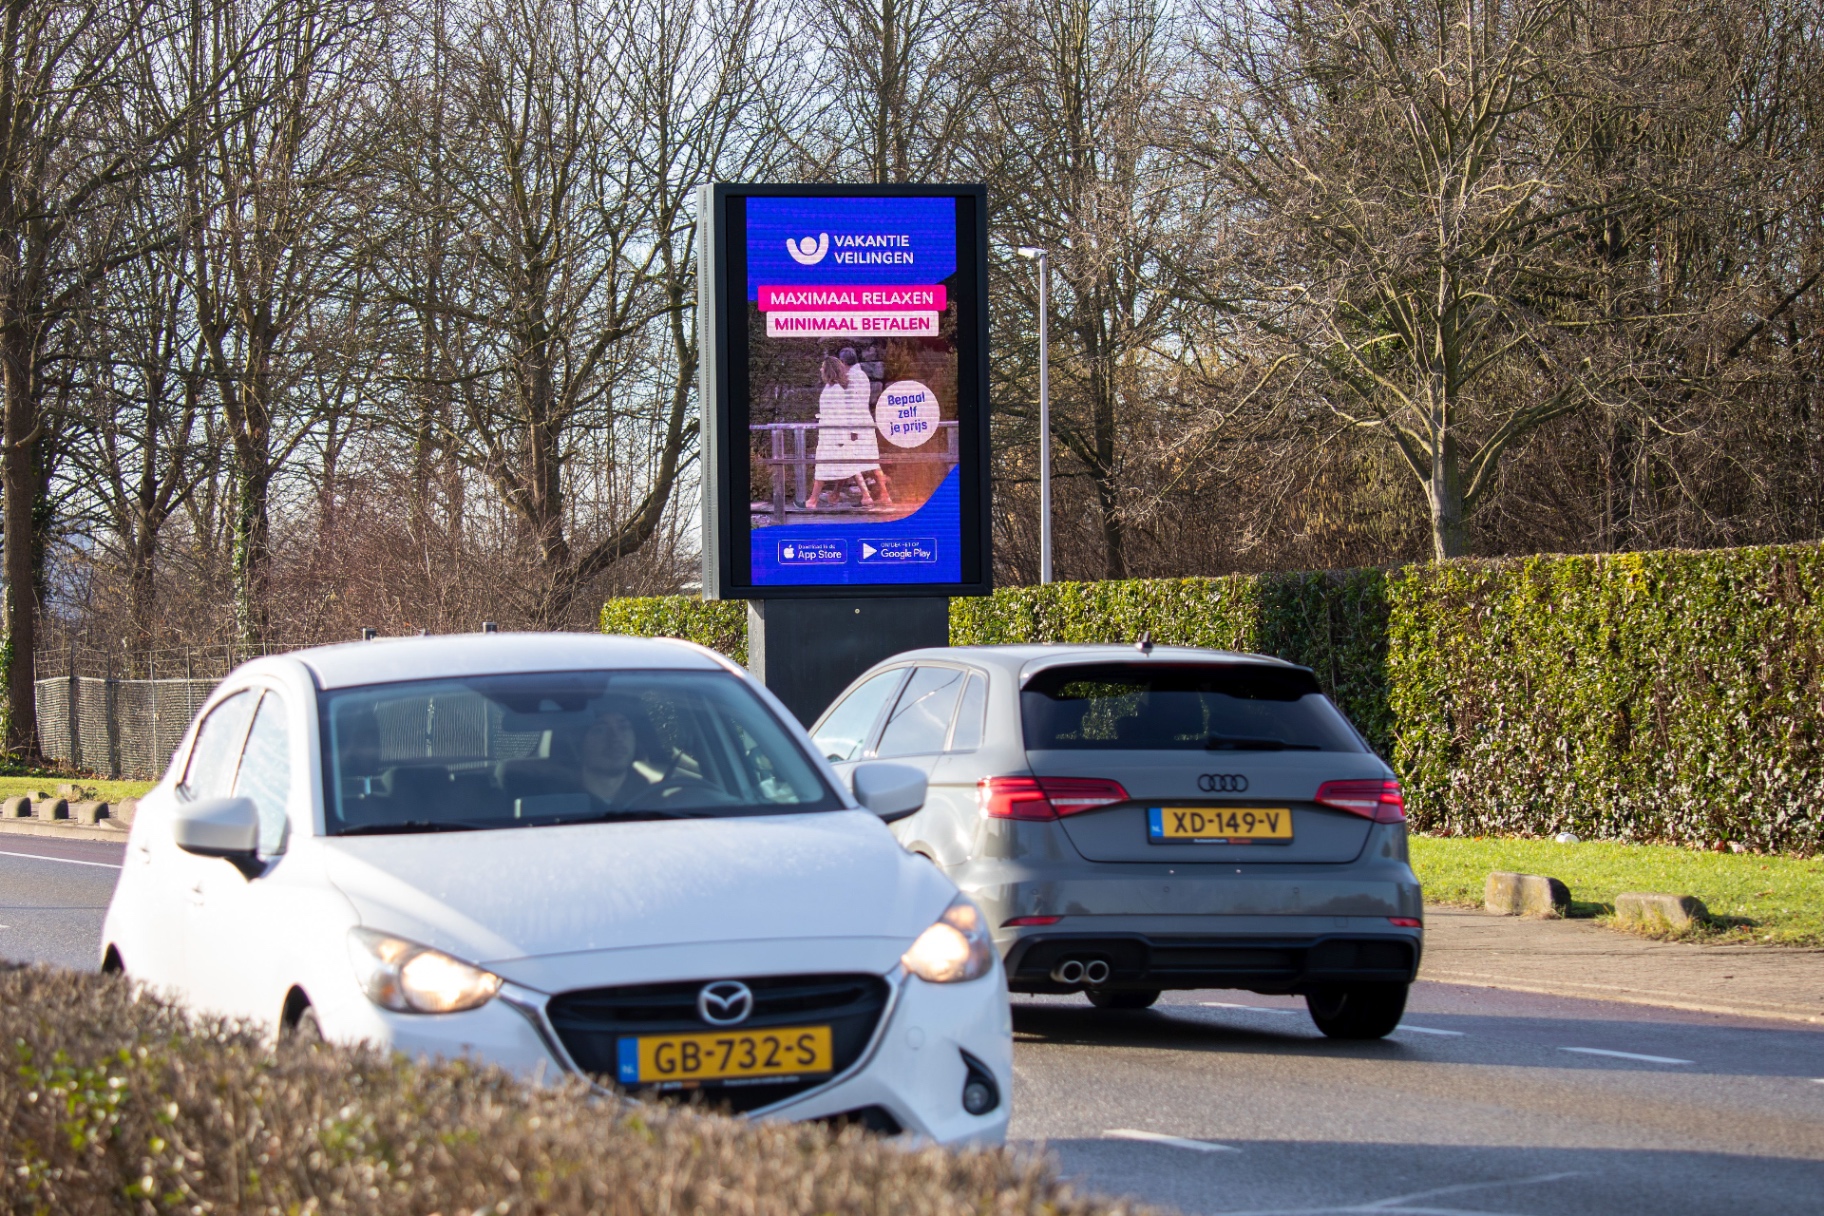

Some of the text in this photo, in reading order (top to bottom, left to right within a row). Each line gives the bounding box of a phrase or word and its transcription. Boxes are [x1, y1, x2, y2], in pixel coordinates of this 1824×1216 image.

[834, 235, 909, 247] VAKANTIE
[834, 252, 914, 264] VEILINGEN
[770, 291, 934, 305] MAXIMAAL RELAXEN
[775, 317, 930, 331] MINIMAAL BETALEN
[887, 391, 925, 406] Bepaal
[898, 405, 917, 419] zelf
[890, 419, 928, 436] je prijs
[798, 550, 842, 561] App Store
[881, 548, 931, 560] Google Play
[1173, 811, 1279, 833] XD-149-V
[654, 1033, 817, 1075] GB-732-S
